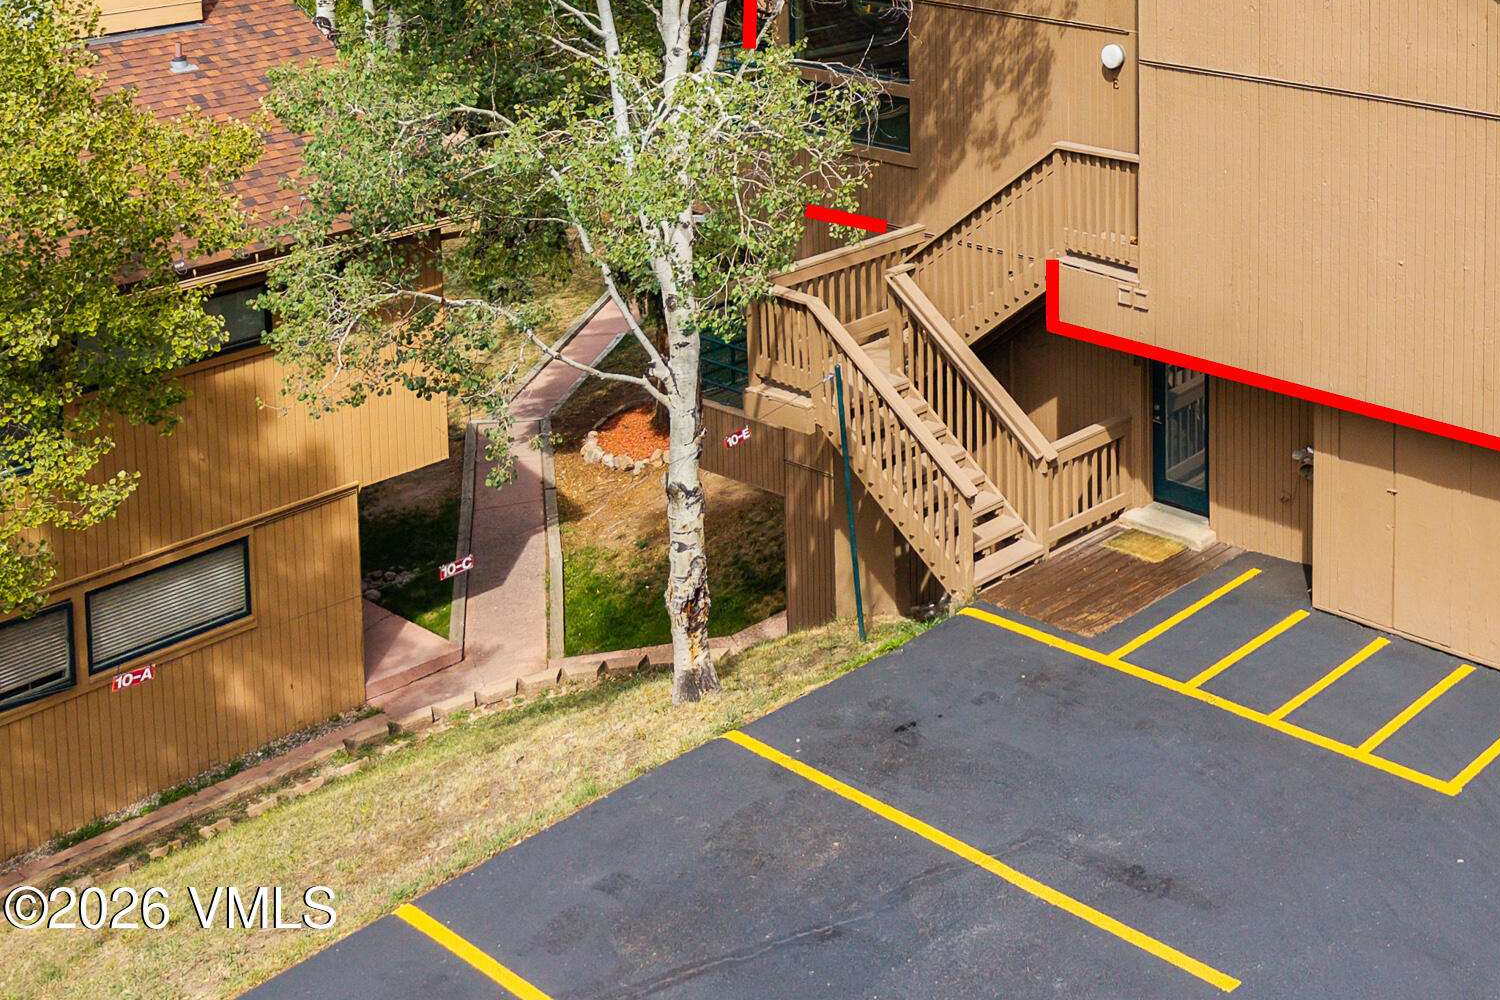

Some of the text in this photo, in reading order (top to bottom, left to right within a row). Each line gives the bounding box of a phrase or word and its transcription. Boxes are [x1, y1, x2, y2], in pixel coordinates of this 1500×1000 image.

[726, 427, 751, 447] 10-E
[442, 556, 472, 577] 10-C
[115, 667, 153, 689] 10-A
